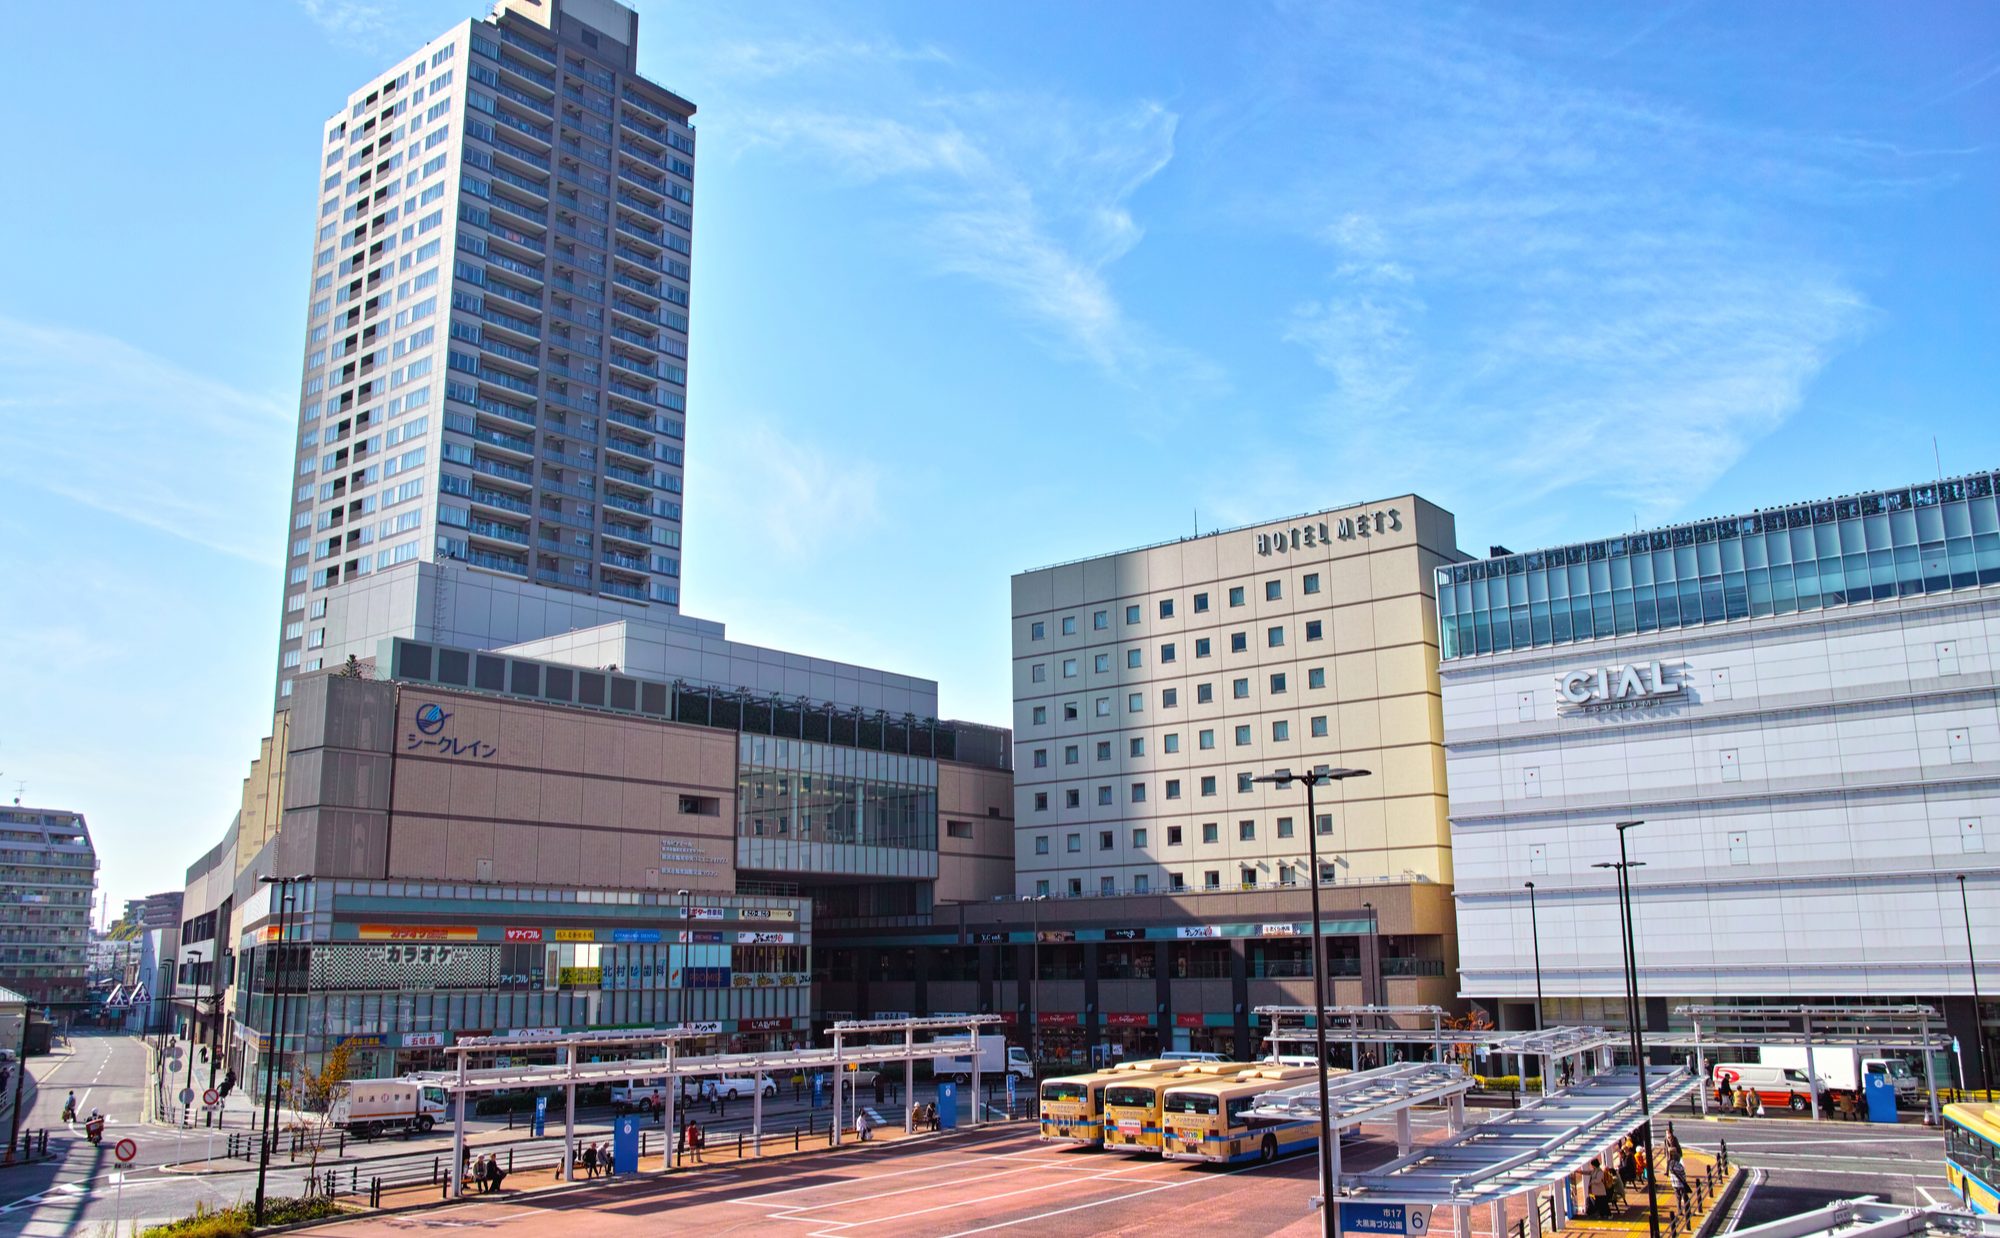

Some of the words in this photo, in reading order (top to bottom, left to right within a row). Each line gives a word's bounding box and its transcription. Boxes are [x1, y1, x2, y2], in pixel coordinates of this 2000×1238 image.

[1256, 521, 1328, 554] HOTEL
[1337, 507, 1401, 538] METS
[1562, 660, 1679, 704] CIAL
[1582, 699, 1663, 713] TSURUMI
[407, 733, 497, 758] シークレイン
[515, 929, 540, 939] アイフル
[225, 948, 231, 956] P
[386, 946, 452, 964] カラオケ
[501, 974, 529, 983] アイフル
[695, 1022, 717, 1031] かつや
[1382, 1208, 1402, 1217] 市17
[1355, 1219, 1403, 1230] 大黒海づり公園
[1411, 1211, 1424, 1229] 6
